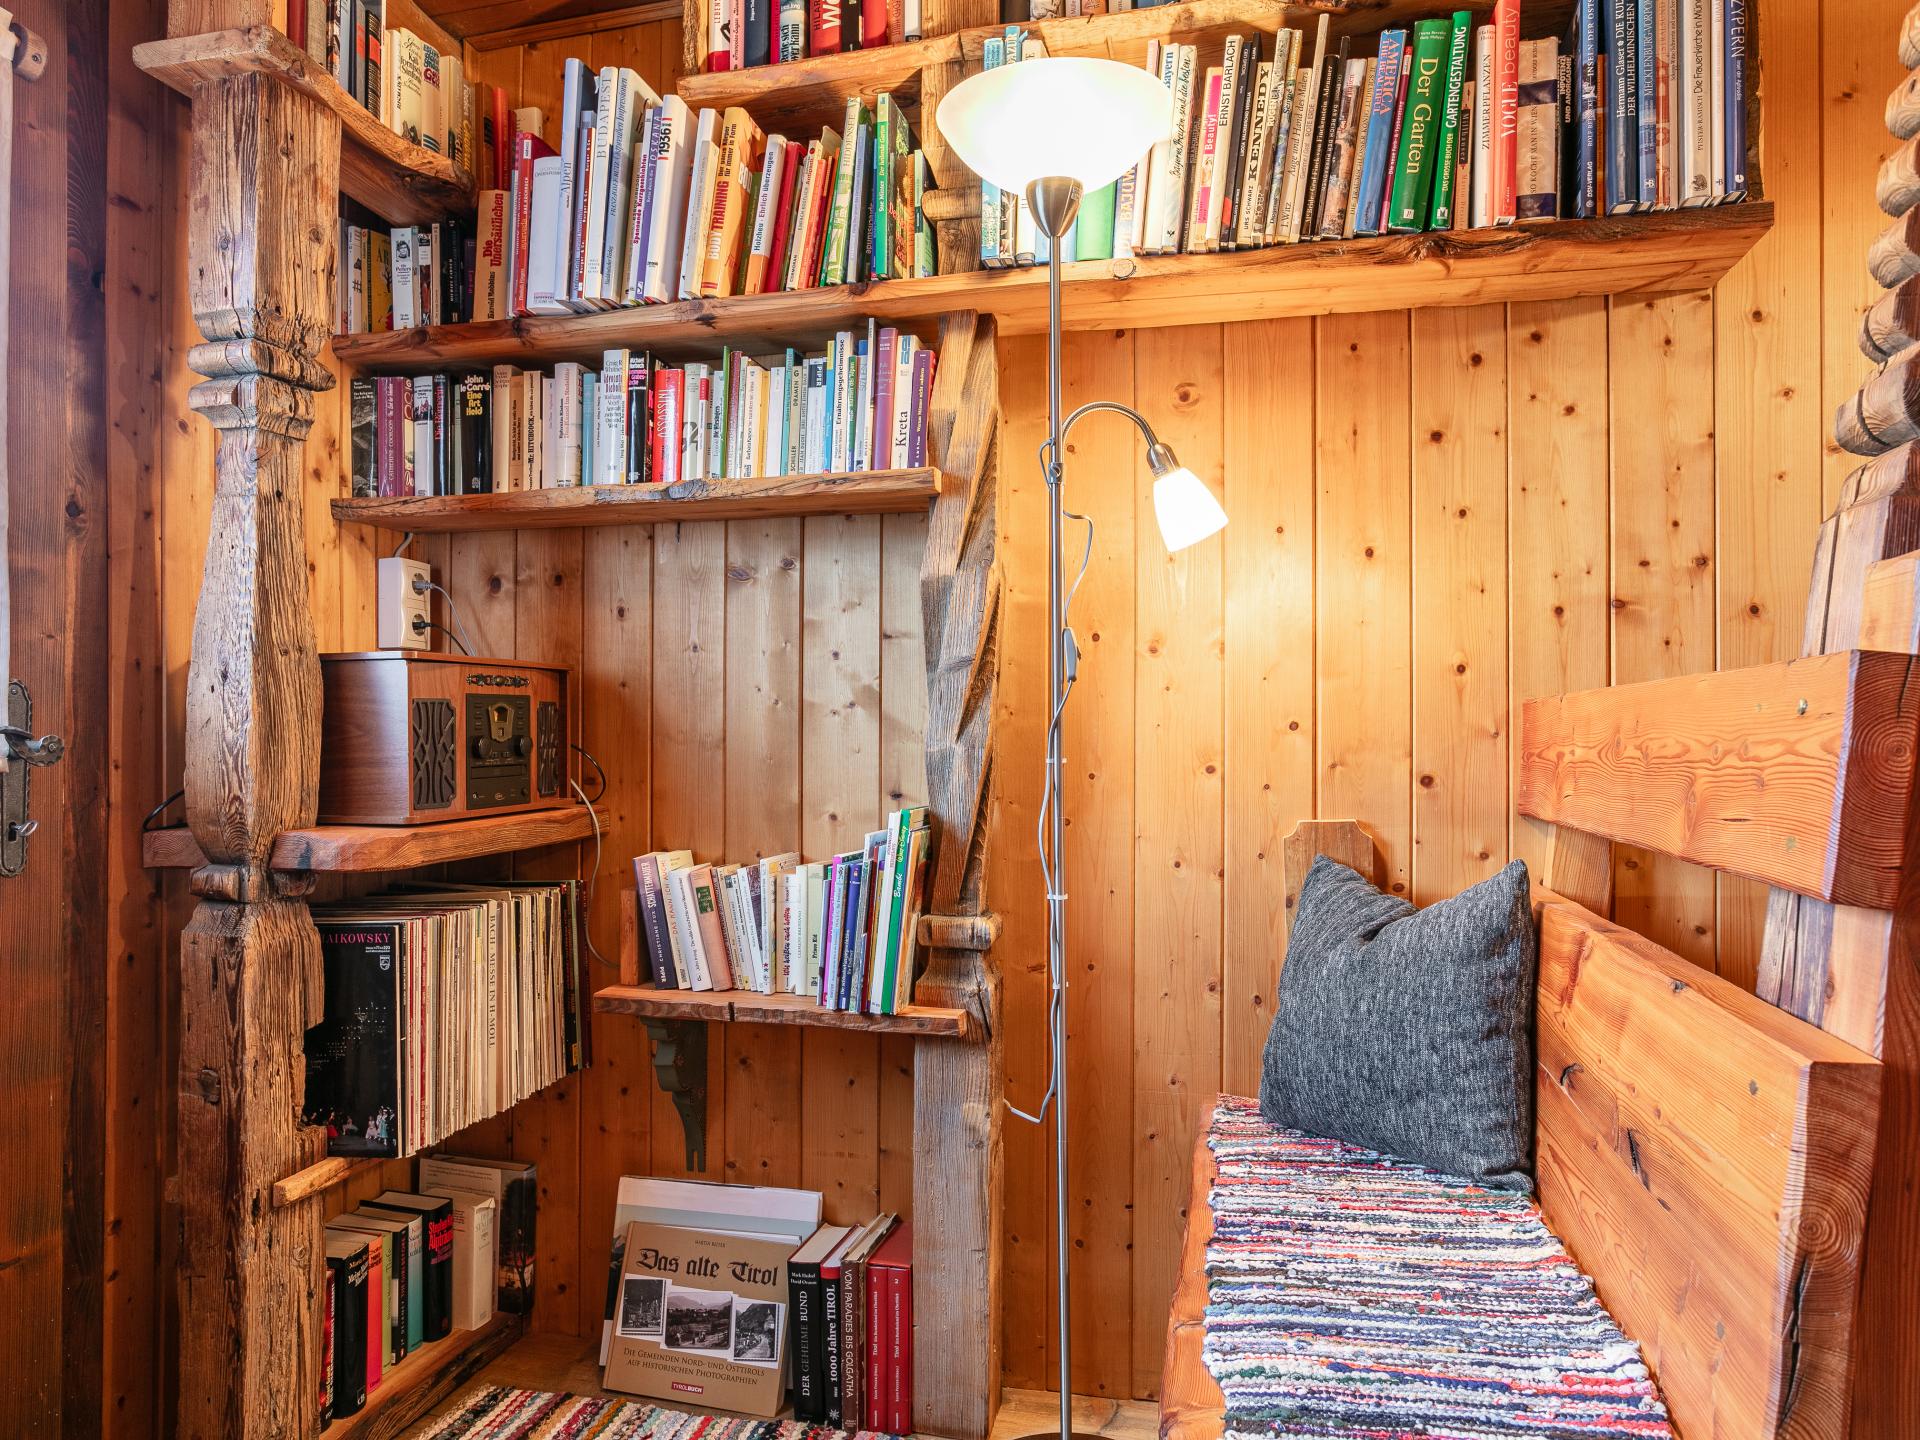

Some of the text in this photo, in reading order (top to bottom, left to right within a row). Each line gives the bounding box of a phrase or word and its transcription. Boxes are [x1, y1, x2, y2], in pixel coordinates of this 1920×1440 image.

[790, 24, 799, 45] kann
[1616, 21, 1625, 38] DIE
[1587, 23, 1595, 76] INSELN DER
[1616, 47, 1625, 75] Glaser
[1626, 3, 1636, 116] DER WILHELMINISCHEN
[1694, 30, 1703, 78] Frauenkirche
[1219, 40, 1236, 127] ERNST BARLACH
[1379, 38, 1400, 114] AMERICA
[1445, 26, 1467, 128] GARTENGESTALTUNG
[1500, 7, 1518, 138] VOGUE beauty
[1694, 80, 1703, 94] Die
[1406, 57, 1439, 174] Der Garten
[1481, 54, 1491, 150] ZIMMERPFLANZEN
[1530, 106, 1538, 125] WIEN
[1616, 77, 1625, 118] Hermann
[596, 76, 612, 159] BUDAPEST
[1204, 113, 1217, 150] Beauty!
[1248, 66, 1269, 180] KENNEDY
[1287, 71, 1309, 176] Auge und Hand des Malers
[648, 116, 661, 168] TOSKANA
[659, 128, 671, 155] 1936
[843, 113, 856, 167] HIDDENSEE
[1444, 144, 1453, 158] BUCH
[561, 162, 572, 194] Alpen
[762, 151, 774, 192] überzeugen
[1442, 159, 1452, 179] GROSSE
[1530, 155, 1538, 182] KOCHT
[633, 154, 648, 244] Spannende Kurzgeschichten
[759, 193, 769, 218] Ehrlich
[1245, 185, 1254, 215] SCHWARZ
[1529, 184, 1537, 193] SO
[1282, 202, 1292, 220] Witz
[491, 193, 503, 267] Unersättlichen
[483, 240, 493, 257] Die
[465, 375, 483, 383] John
[466, 383, 491, 391] Carré
[466, 407, 483, 416] Held
[895, 411, 908, 447] Kreta
[894, 873, 903, 898] Bambi
[654, 926, 664, 961] CHRISTIANE
[636, 1248, 679, 1274] Das
[686, 1257, 719, 1277] alte
[727, 1260, 778, 1287] Tirol
[800, 1291, 810, 1396] DER GEHEIME BUND
[826, 1285, 838, 1382] 1000 Jahre TIROL
[844, 1269, 854, 1398] VOM PARADIES BIS GOLGATHA
[624, 1347, 765, 1376] DIE GEMEINDEN NORD- UND OSTTIROLS
[628, 1359, 758, 1385] AUF HISTORISCHEN PHOTOGRAPHIEN
